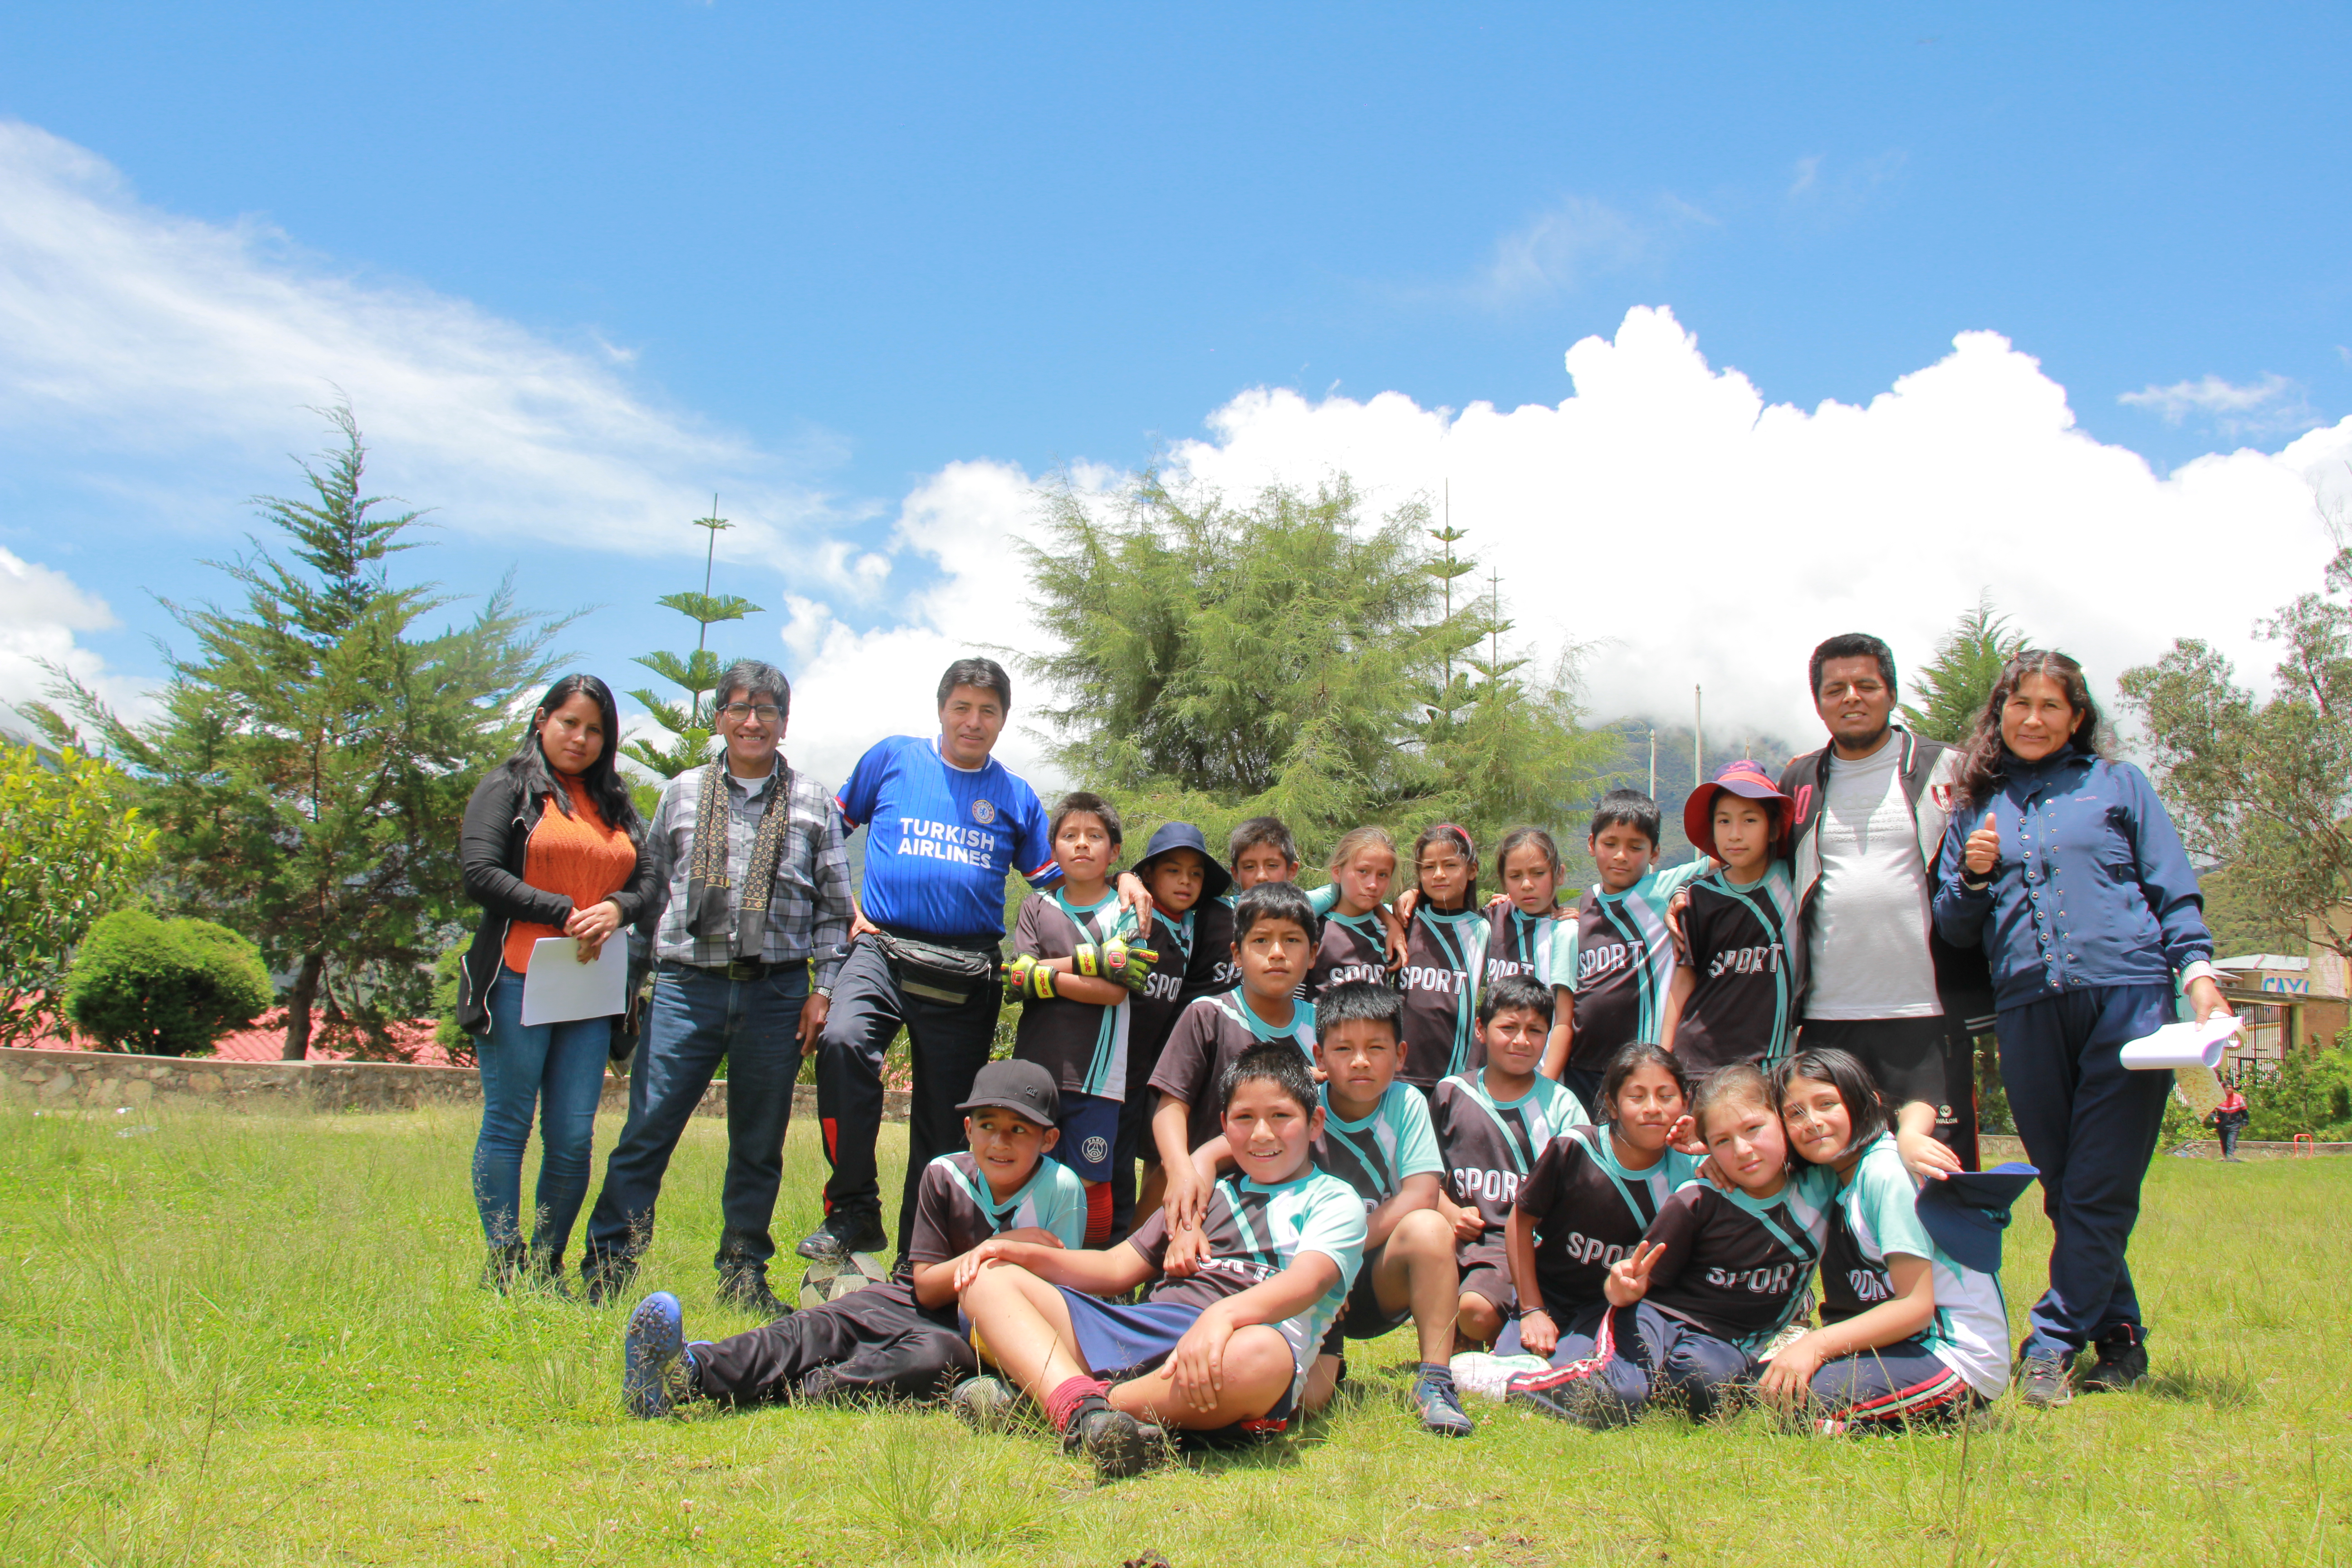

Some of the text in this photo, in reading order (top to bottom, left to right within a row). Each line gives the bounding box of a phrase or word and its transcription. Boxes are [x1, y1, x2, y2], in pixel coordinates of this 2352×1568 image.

[1824, 791, 1886, 810] didas
[900, 818, 995, 852] TURKISH
[898, 837, 992, 869] AIRLINES
[1213, 962, 1245, 985] SP
[1330, 964, 1386, 986] SPOR
[1487, 958, 1535, 983] PORT
[1579, 940, 1643, 979] SPORT
[1708, 943, 1783, 978] SPORT
[1400, 965, 1468, 995] SPORT
[1453, 1167, 1529, 1203] SPOR
[1706, 1259, 1816, 1294] SPORT
